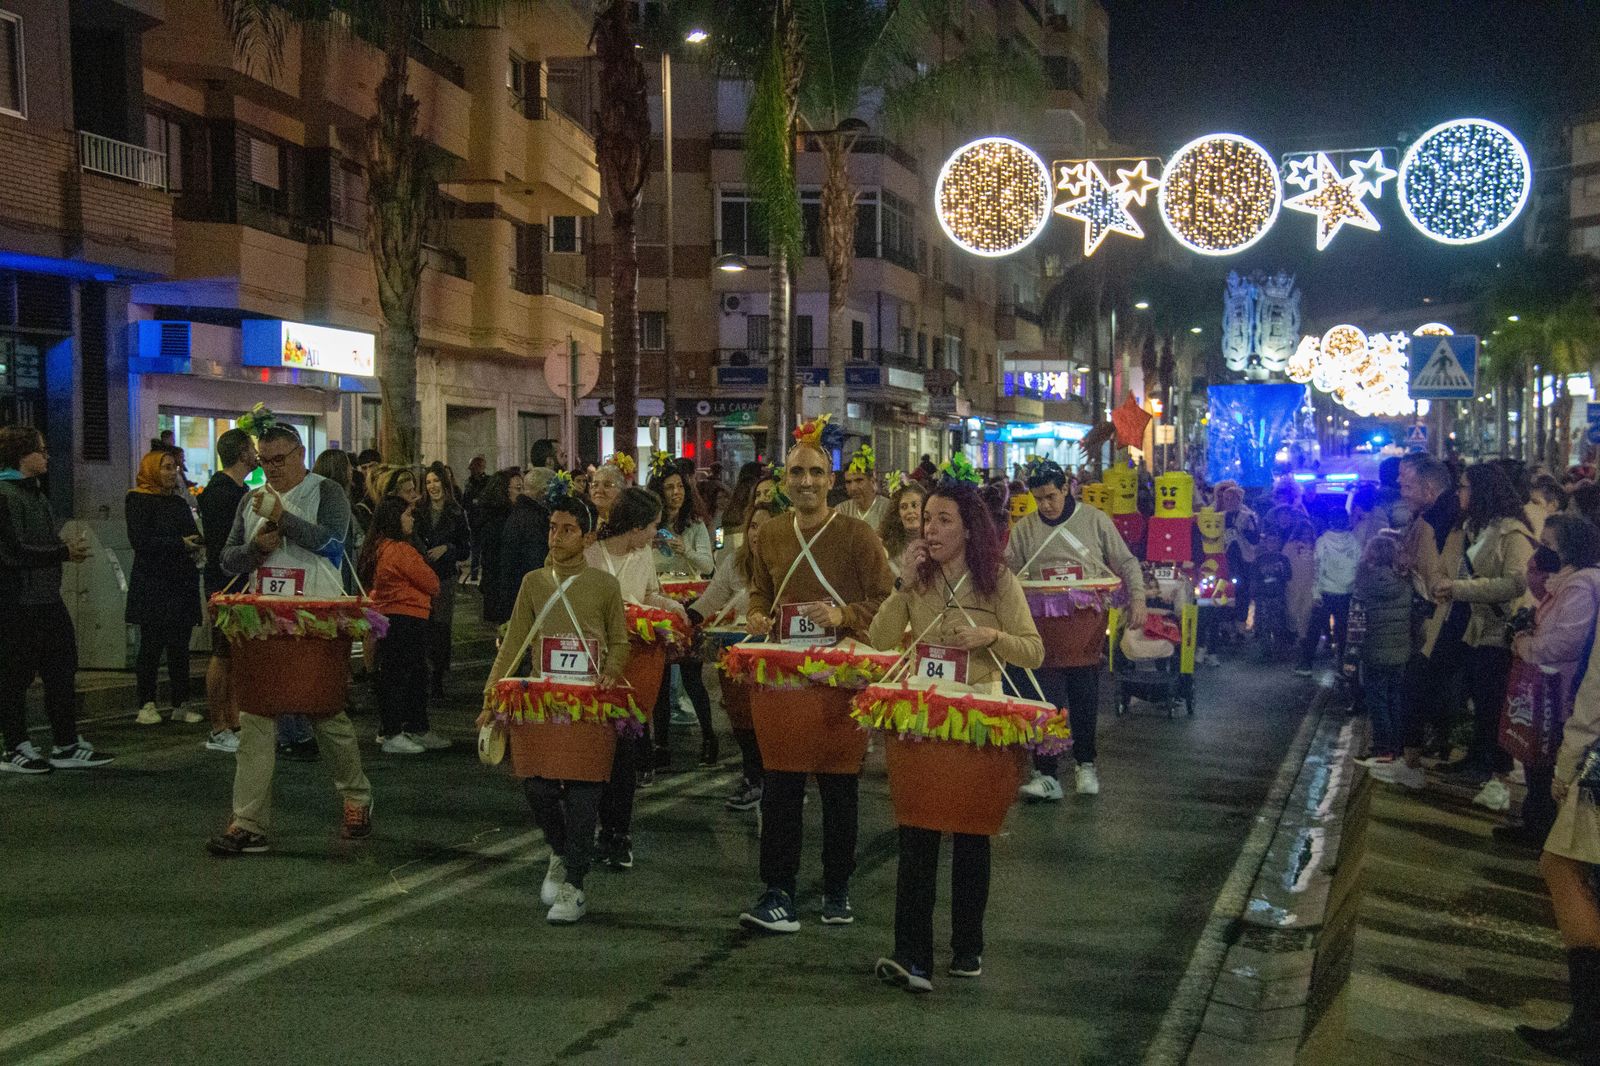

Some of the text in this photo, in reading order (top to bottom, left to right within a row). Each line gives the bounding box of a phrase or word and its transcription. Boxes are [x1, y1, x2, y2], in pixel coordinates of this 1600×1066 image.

[1156, 569, 1171, 577] 339
[269, 579, 286, 593] 87
[799, 618, 815, 633] 85
[560, 653, 578, 669] 77
[926, 661, 944, 679] 84
